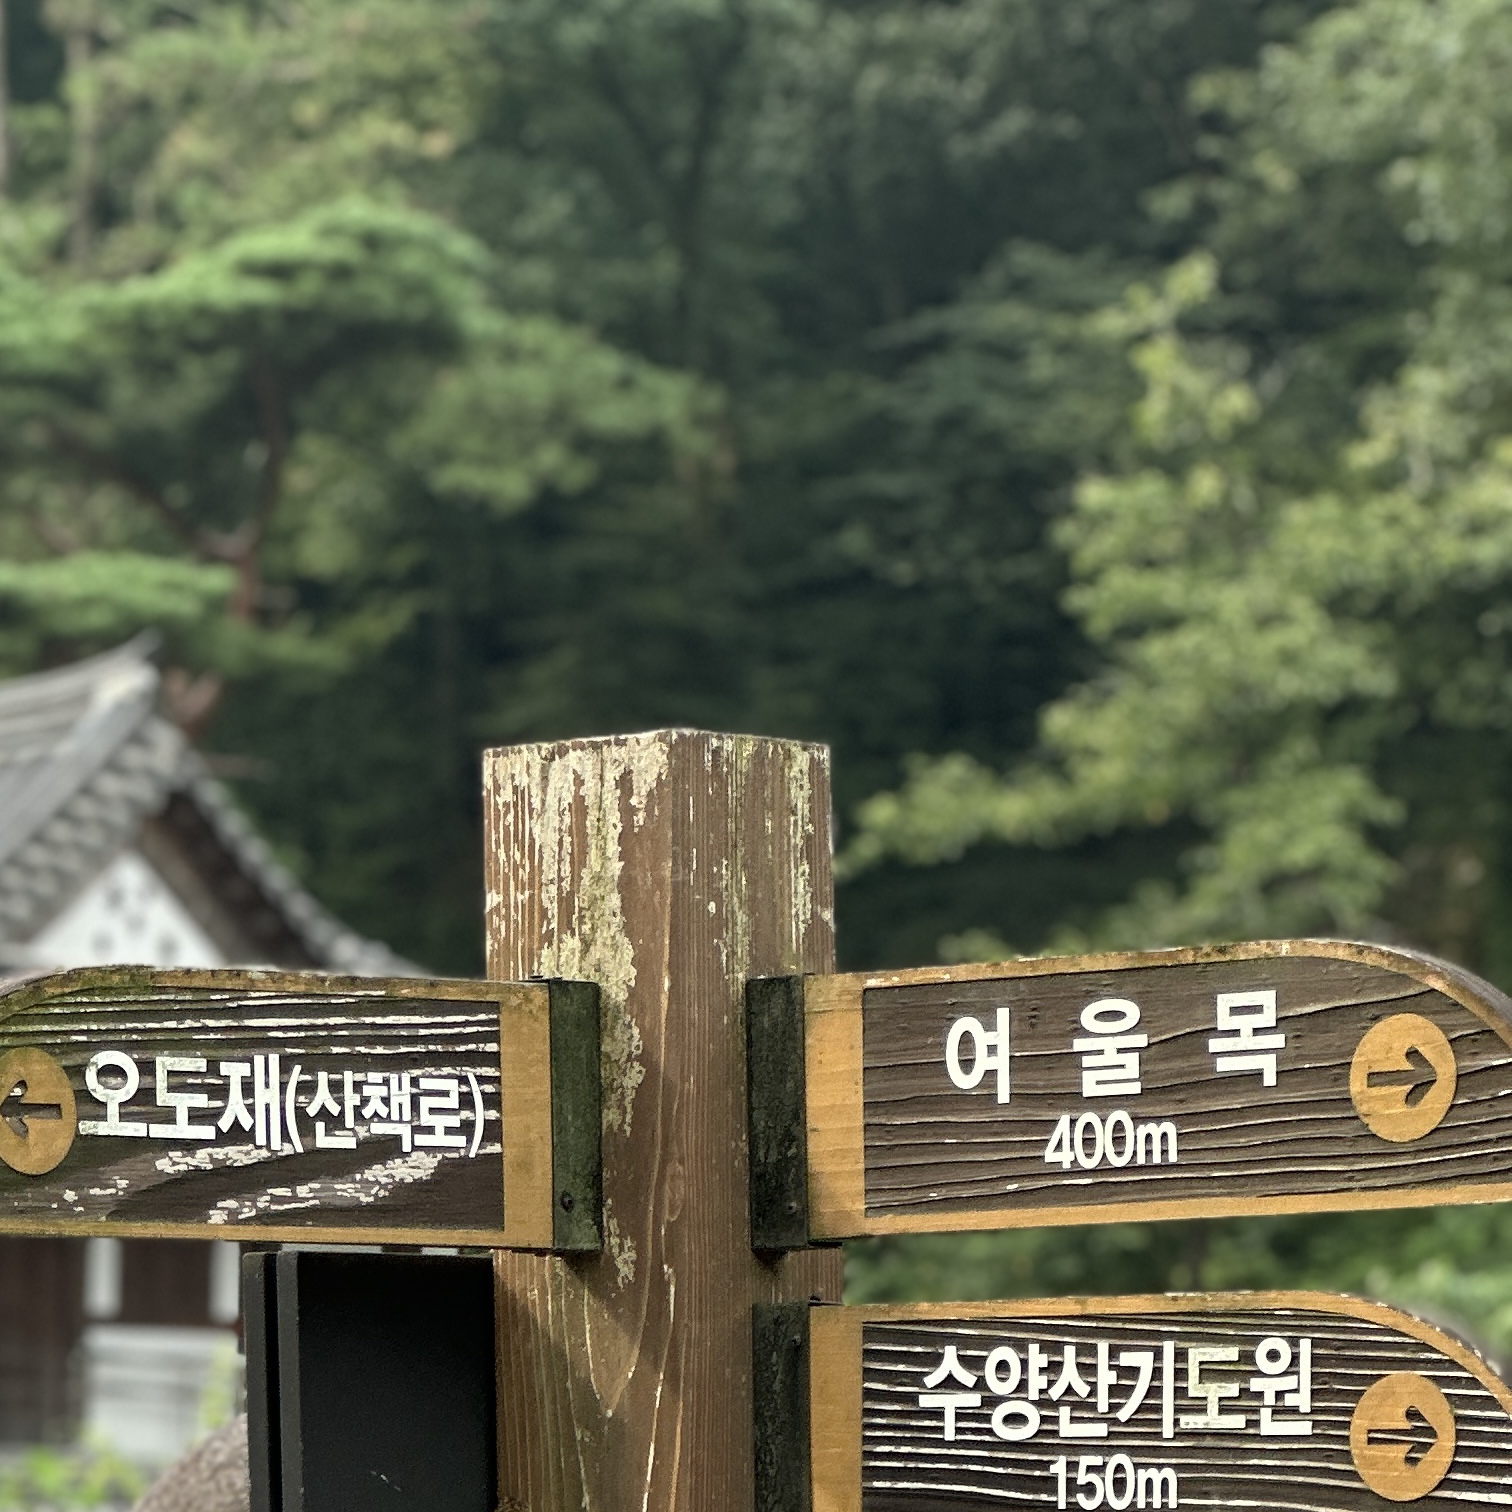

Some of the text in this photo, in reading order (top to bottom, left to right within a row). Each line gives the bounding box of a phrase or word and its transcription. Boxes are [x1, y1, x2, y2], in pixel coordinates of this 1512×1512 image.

[78, 1049, 485, 1157] 오도재(산책로)
[1044, 1110, 1178, 1169] 400m
[917, 1336, 1313, 1442] 수양산기도원
[1048, 1453, 1179, 1511] 150m
